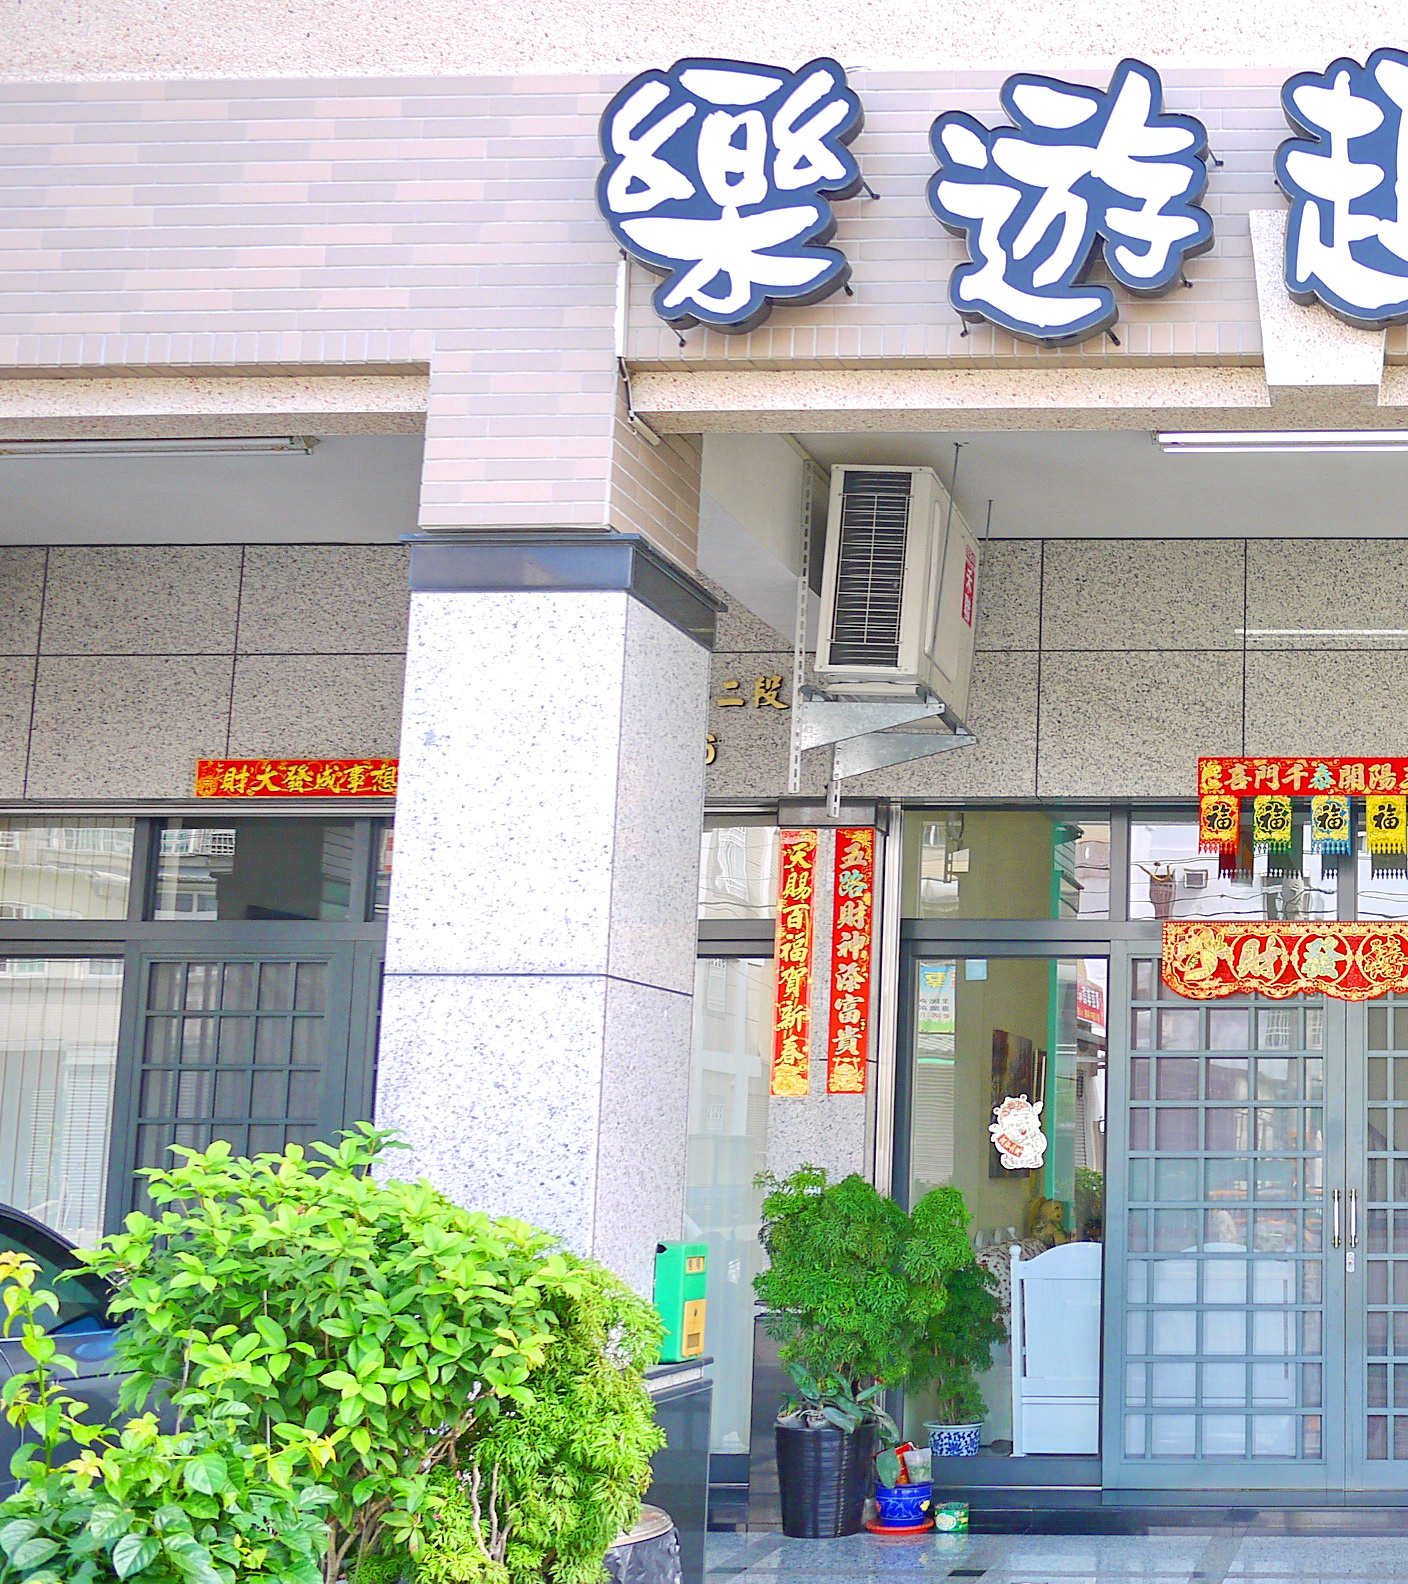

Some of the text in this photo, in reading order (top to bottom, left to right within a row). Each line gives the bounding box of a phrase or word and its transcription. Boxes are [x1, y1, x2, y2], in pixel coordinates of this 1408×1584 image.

[716, 675, 790, 710] 二段
[1206, 804, 1233, 832] 福
[1259, 804, 1288, 832] 福
[1316, 804, 1345, 832] 福
[1372, 804, 1401, 832] 福
[774, 841, 813, 1066] 天賜百福賀新春
[831, 841, 870, 1057] 五路財神添富貴
